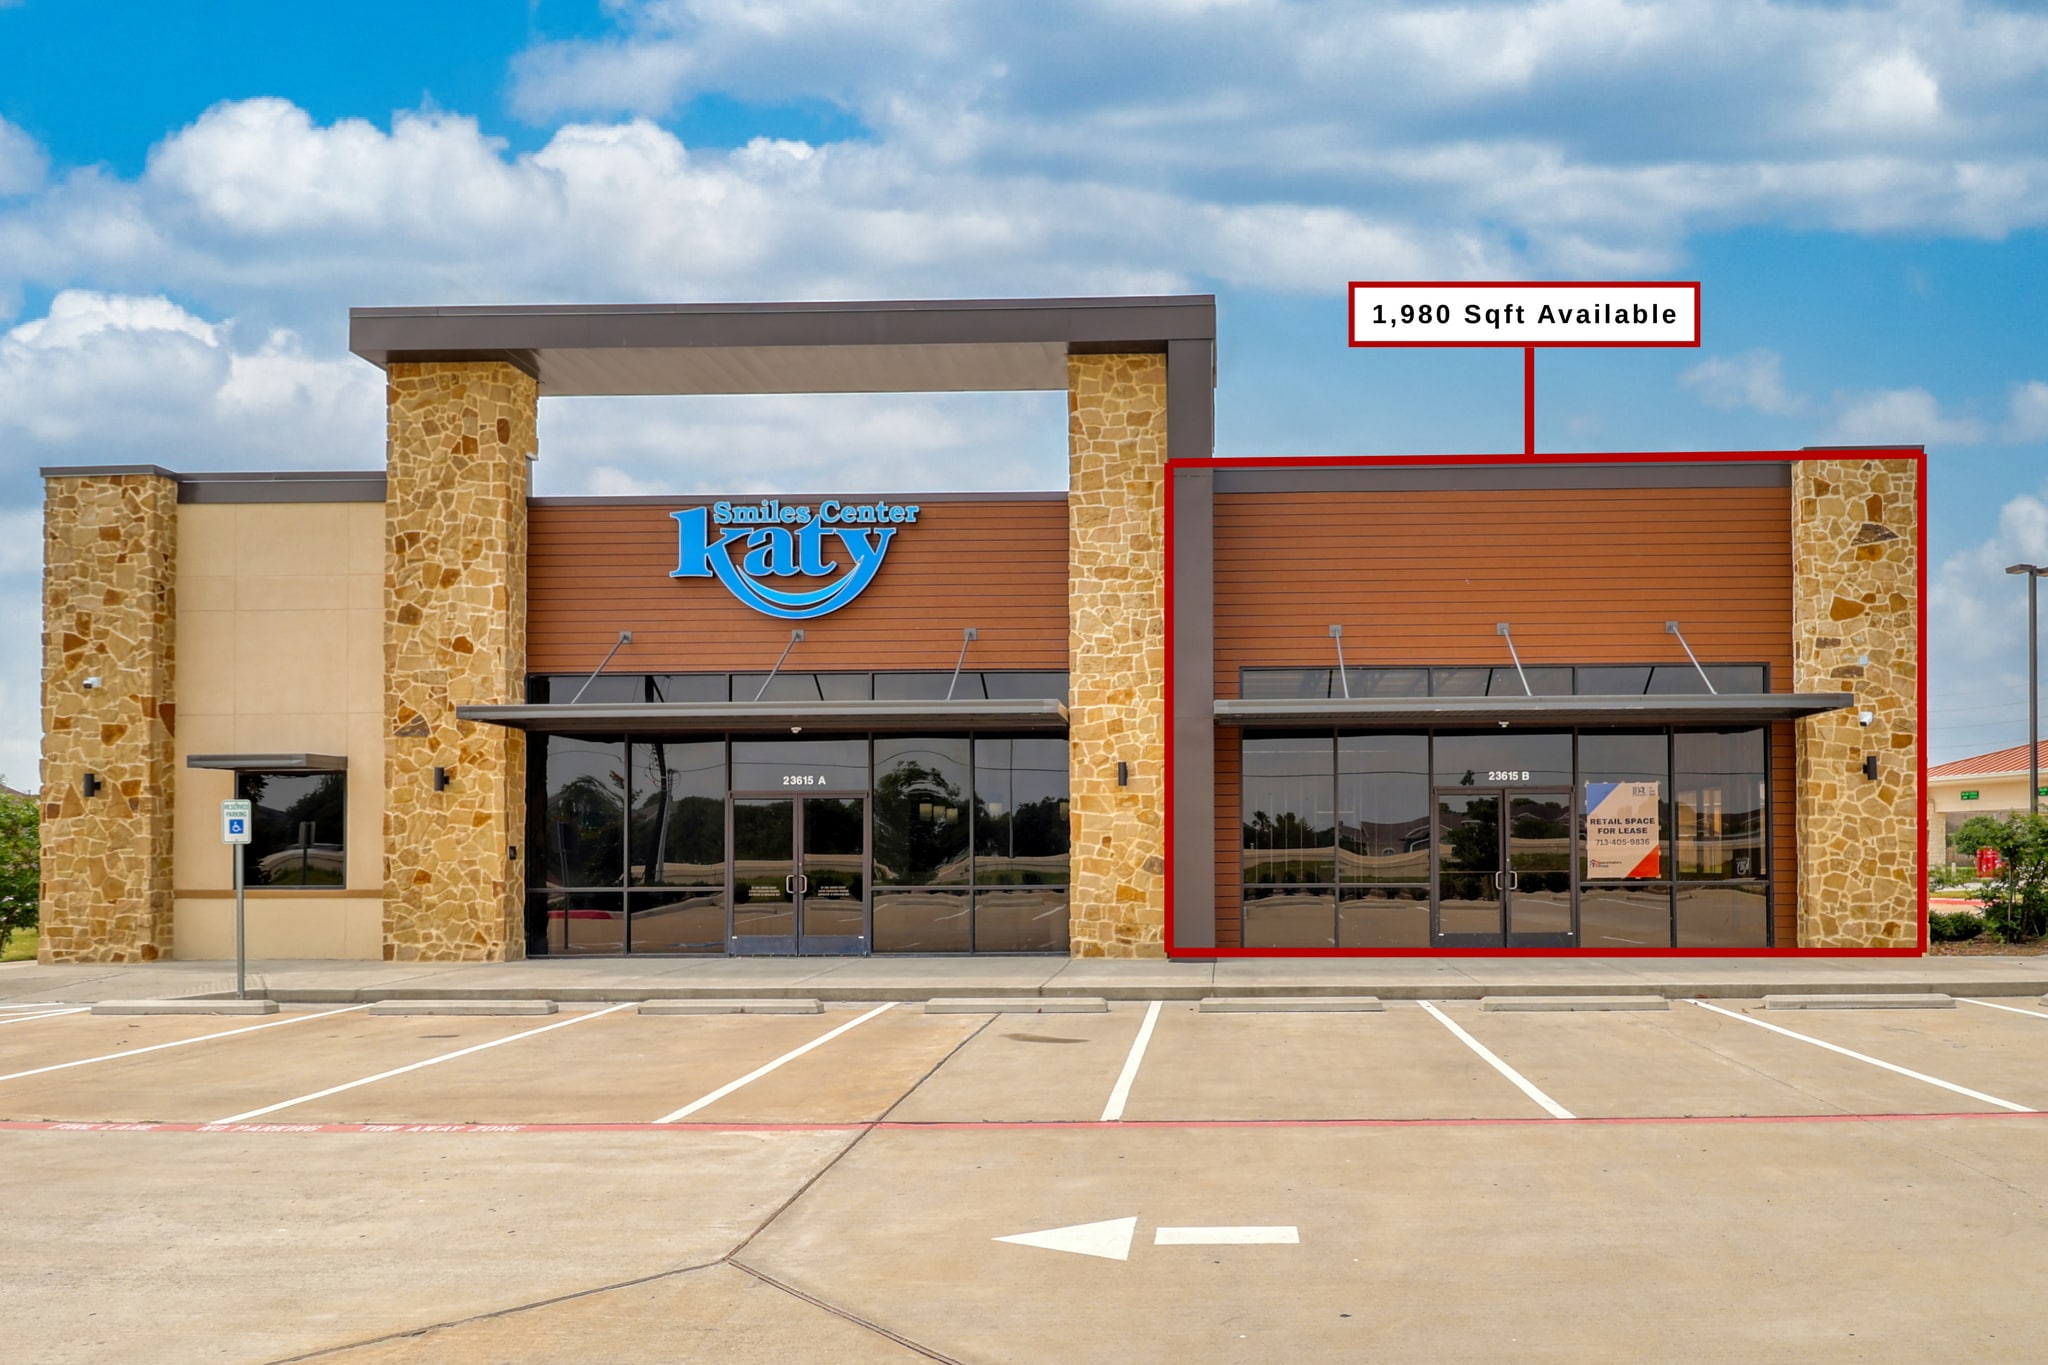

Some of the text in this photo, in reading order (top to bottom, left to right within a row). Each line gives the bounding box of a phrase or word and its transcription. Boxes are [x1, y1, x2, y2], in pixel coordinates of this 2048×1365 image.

[713, 499, 920, 525] Smiles Center
[668, 506, 898, 620] katy
[783, 775, 826, 785] 23615 A
[1488, 771, 1530, 781] 23615 B
[1625, 817, 1655, 825] SPACE
[196, 1124, 323, 1132] NO PARKING
